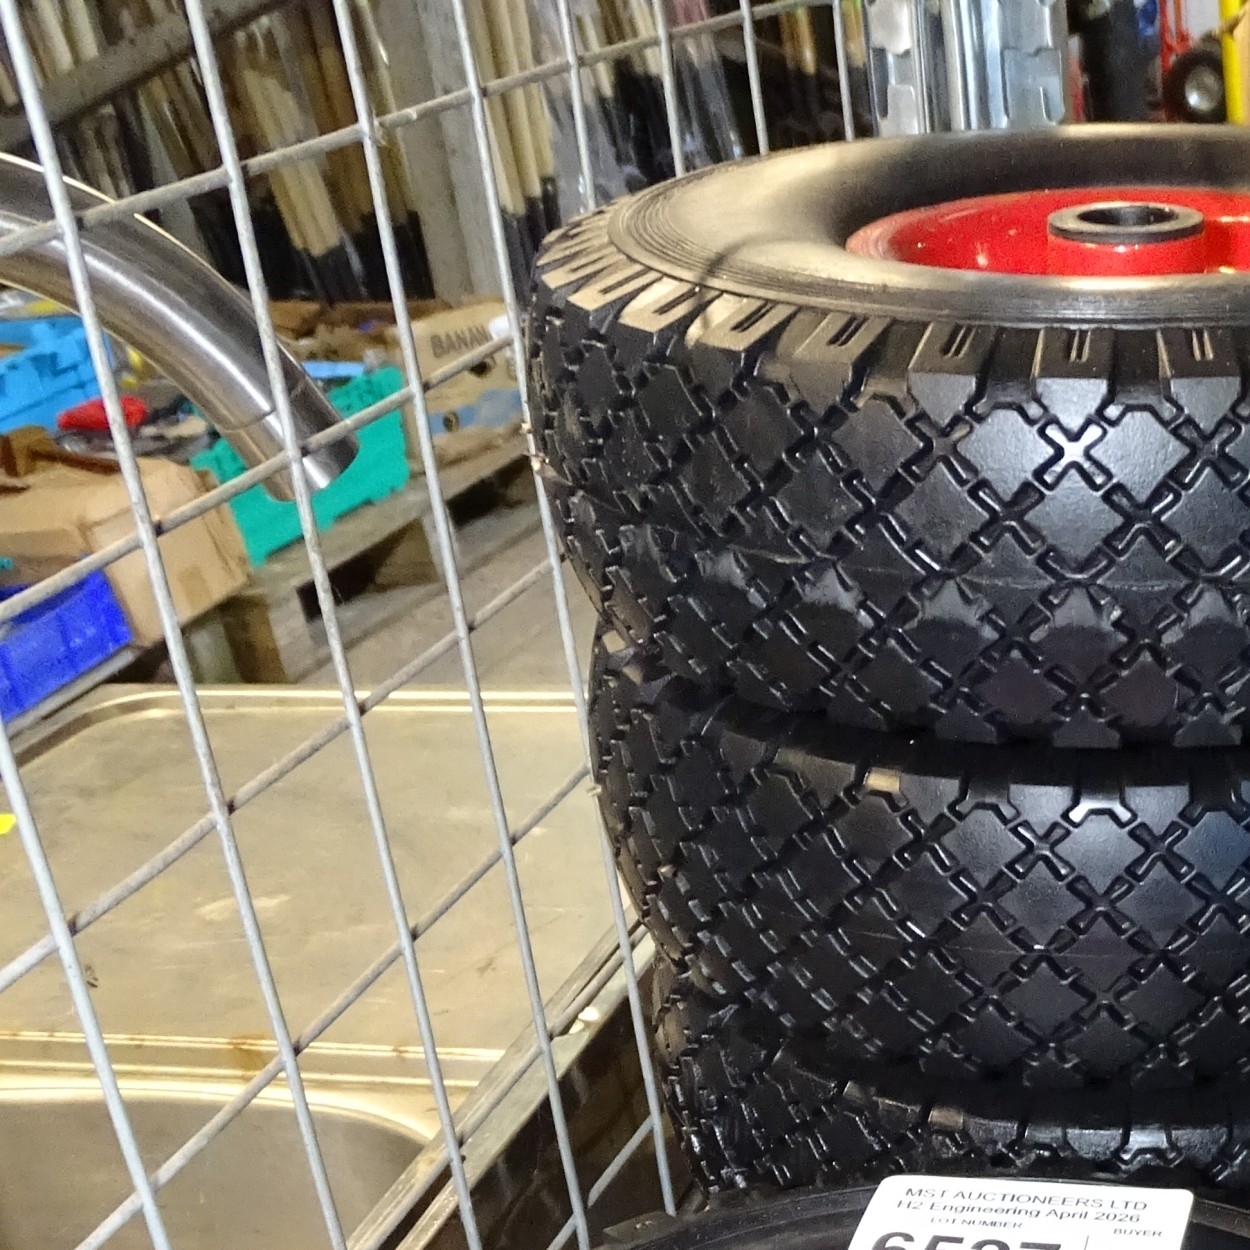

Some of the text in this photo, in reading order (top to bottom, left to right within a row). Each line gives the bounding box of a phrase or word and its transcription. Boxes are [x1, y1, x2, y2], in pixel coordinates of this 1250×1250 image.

[430, 325, 492, 359] BANAN
[897, 1199, 1141, 1223] H2 Engineering April 2026
[906, 1187, 1148, 1211] MST AUCTIONEERS LTD
[930, 1217, 1023, 1229] LOT NUMBER
[1112, 1227, 1163, 1238] BUYER
